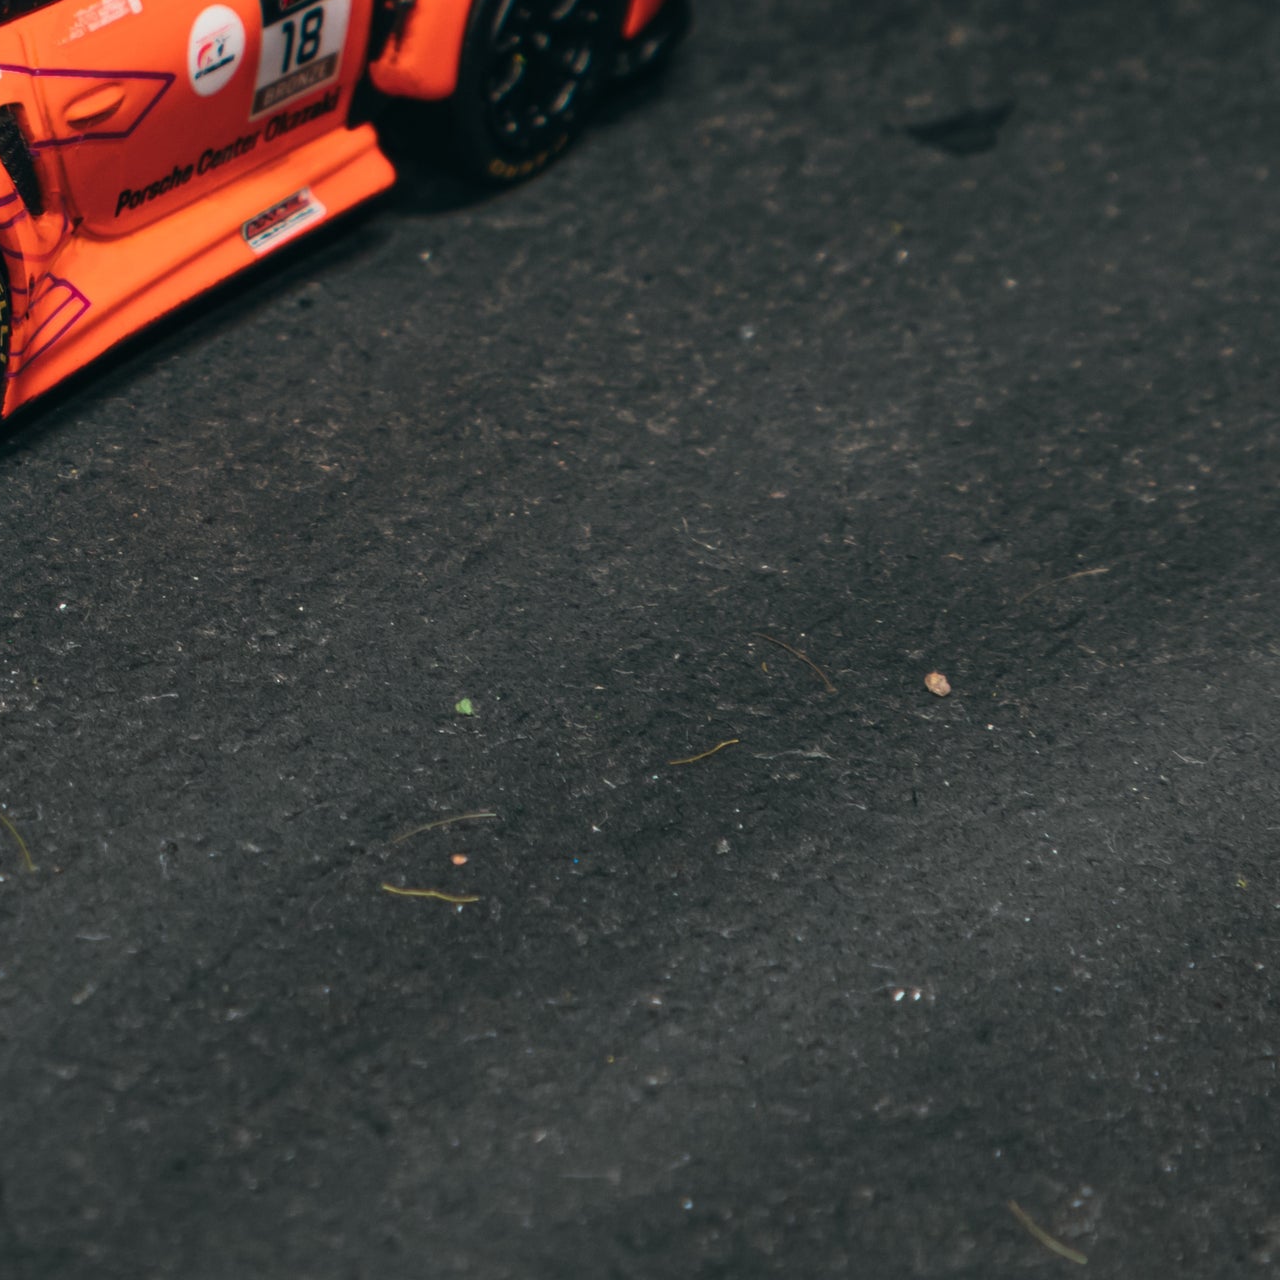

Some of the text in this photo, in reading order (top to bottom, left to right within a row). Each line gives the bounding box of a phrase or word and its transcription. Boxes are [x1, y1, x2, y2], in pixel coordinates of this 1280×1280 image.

[281, 5, 325, 74] 18
[114, 165, 194, 219] Porsche
[196, 130, 260, 176] Center
